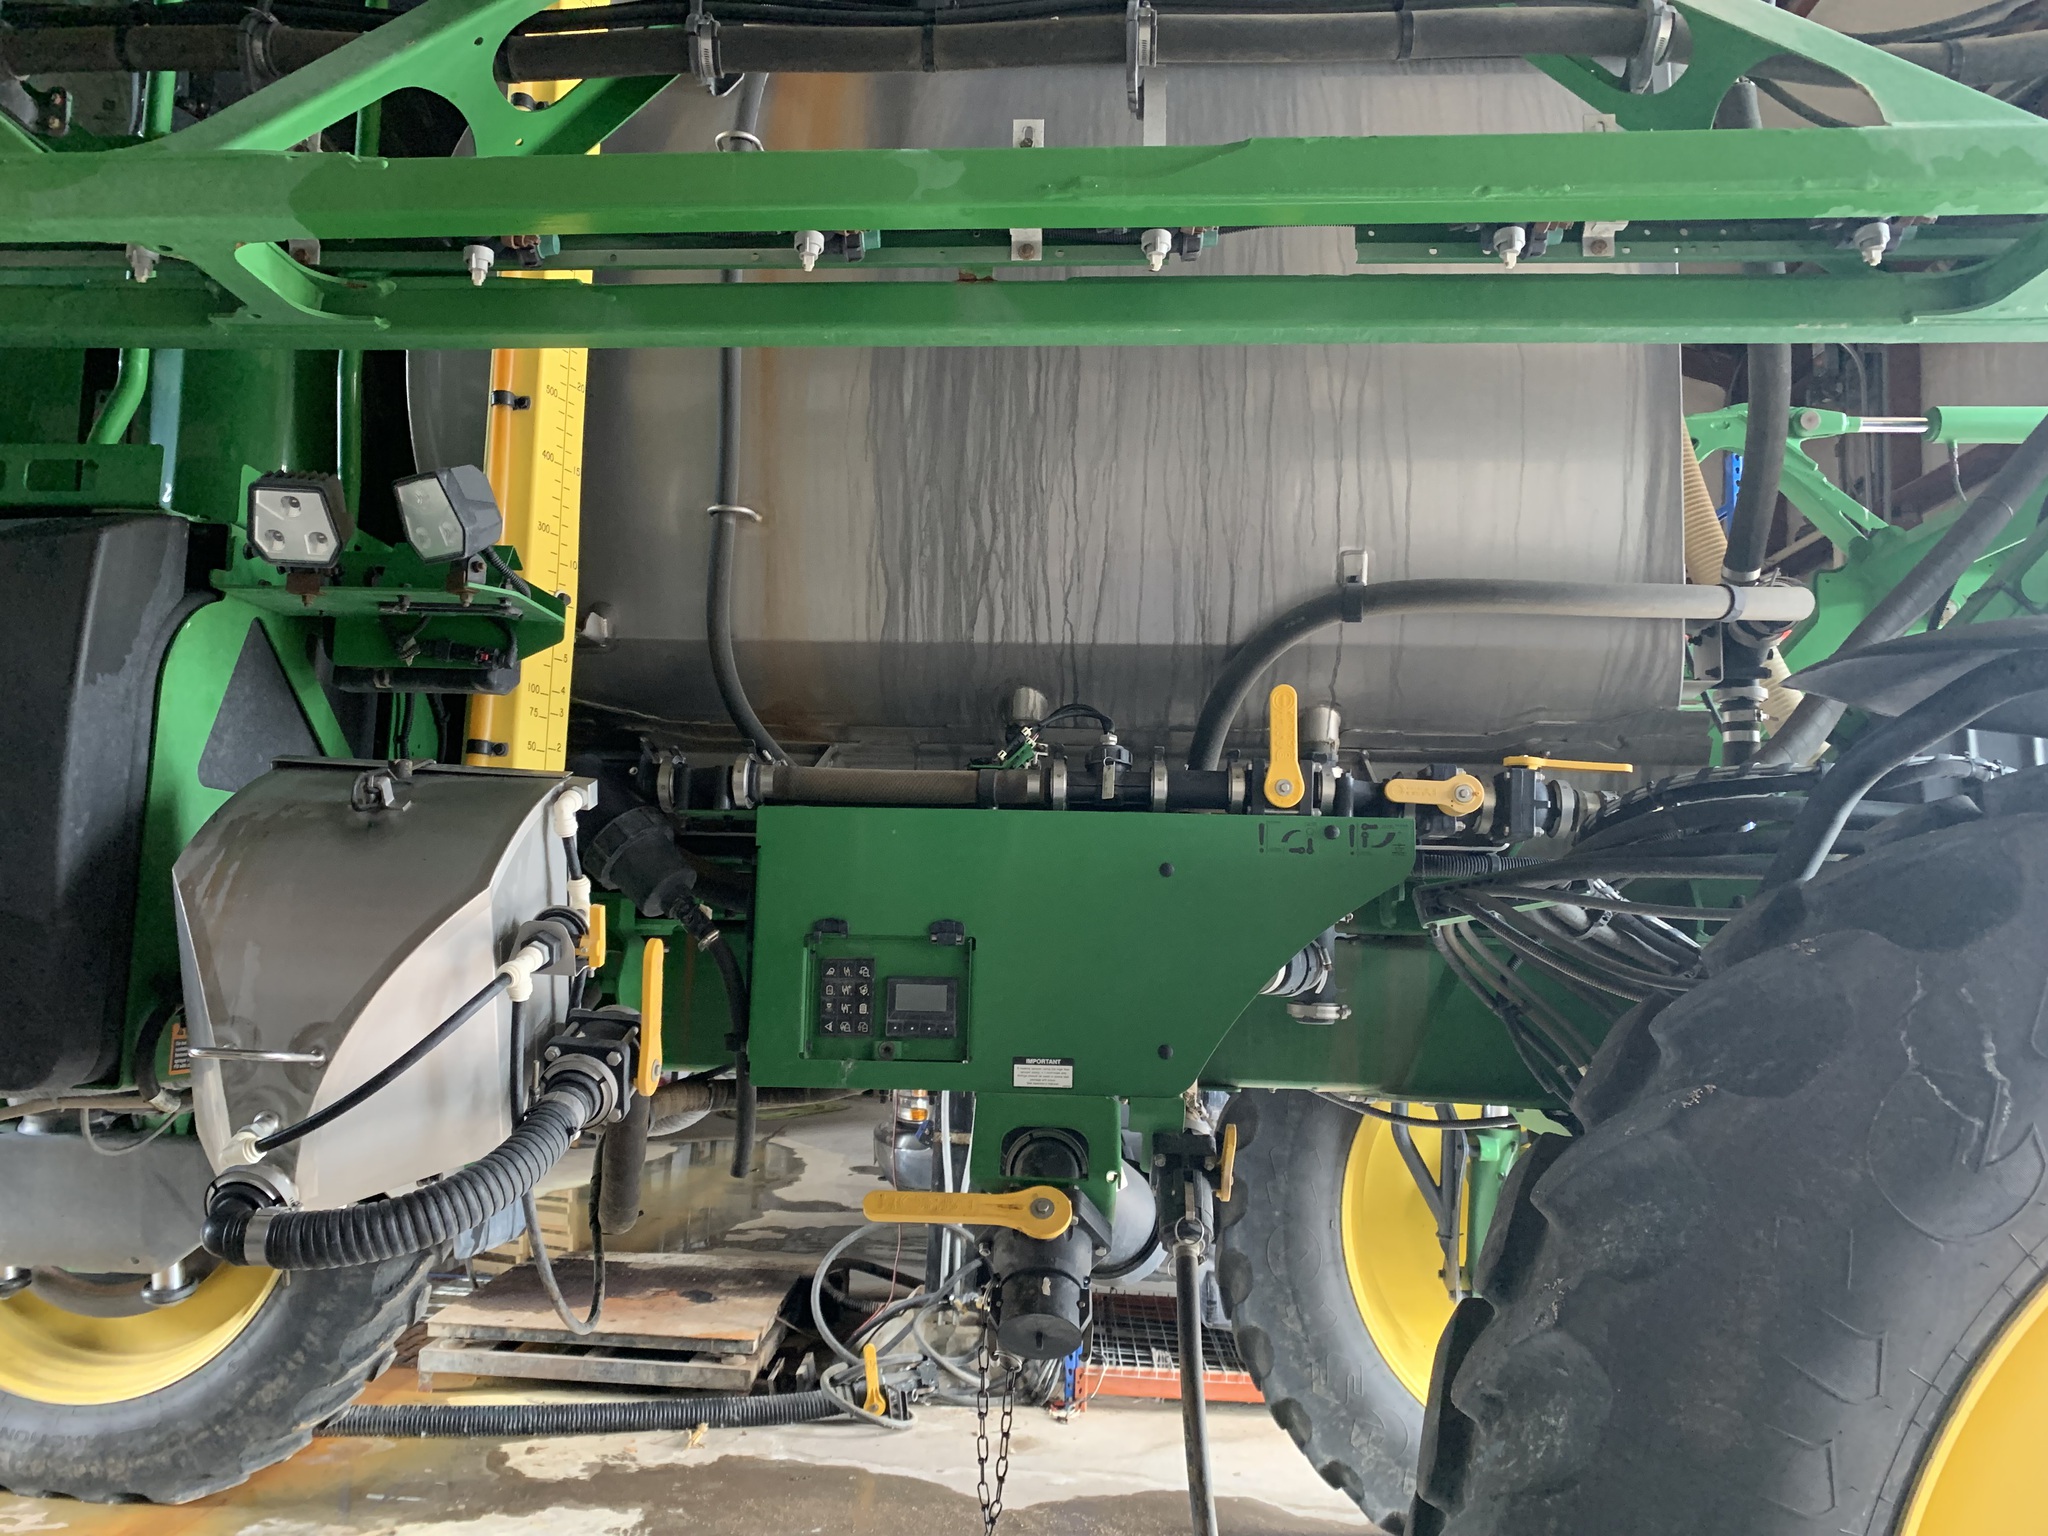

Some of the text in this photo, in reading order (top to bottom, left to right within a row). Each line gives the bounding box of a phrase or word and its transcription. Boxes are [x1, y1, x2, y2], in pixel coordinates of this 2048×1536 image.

[546, 384, 558, 398] 500
[576, 381, 584, 394] 20
[541, 449, 554, 462] 400
[573, 466, 581, 476] 15
[537, 520, 550, 534] 300
[569, 559, 578, 570] 10
[528, 683, 540, 694] 100
[529, 706, 539, 718] 75
[527, 740, 537, 751] 50
